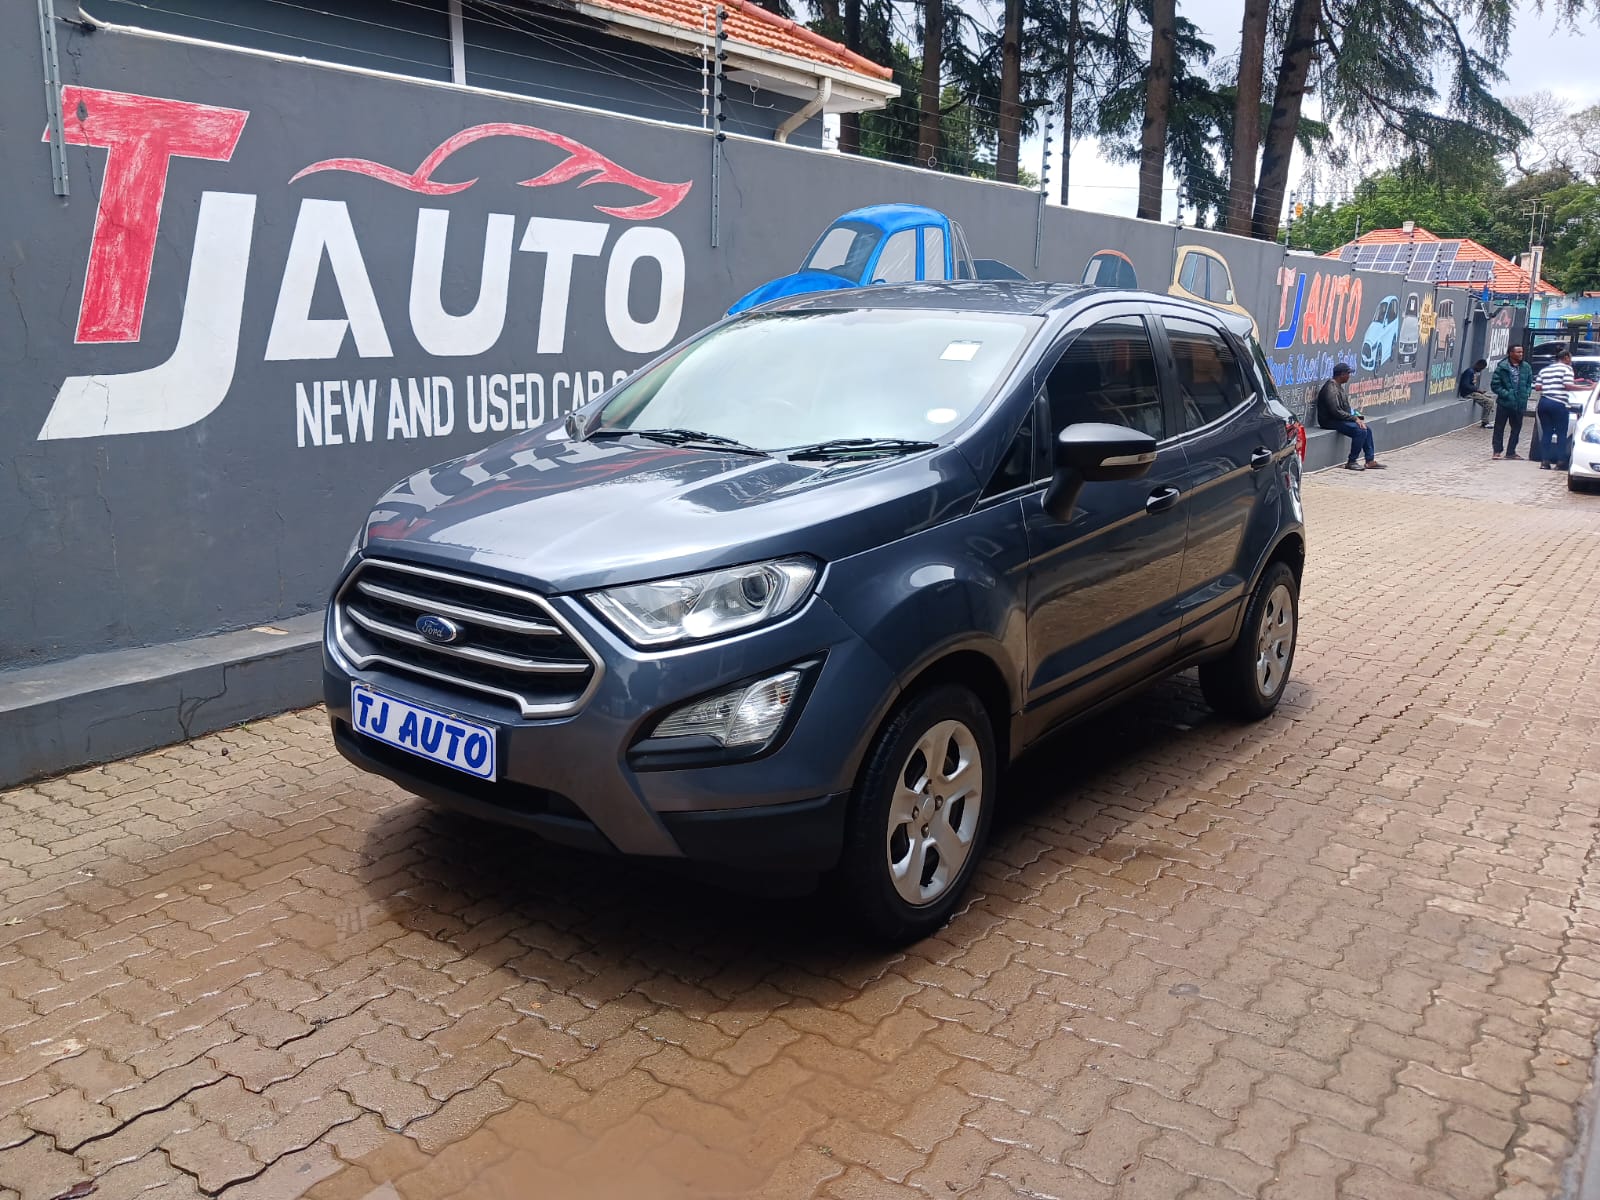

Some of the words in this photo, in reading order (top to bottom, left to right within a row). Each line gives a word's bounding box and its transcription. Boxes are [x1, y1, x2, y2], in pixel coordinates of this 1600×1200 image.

[37, 85, 257, 440] TJ
[264, 198, 686, 360] AUTO
[1274, 266, 1306, 349] TJ
[1302, 271, 1362, 344] AUTO
[1296, 350, 1321, 385] Used
[296, 379, 377, 447] NEW
[387, 376, 454, 439] AND
[467, 372, 545, 433] USED
[421, 620, 444, 638] Ford
[357, 693, 390, 734] TJ
[398, 710, 488, 769] AUTO
